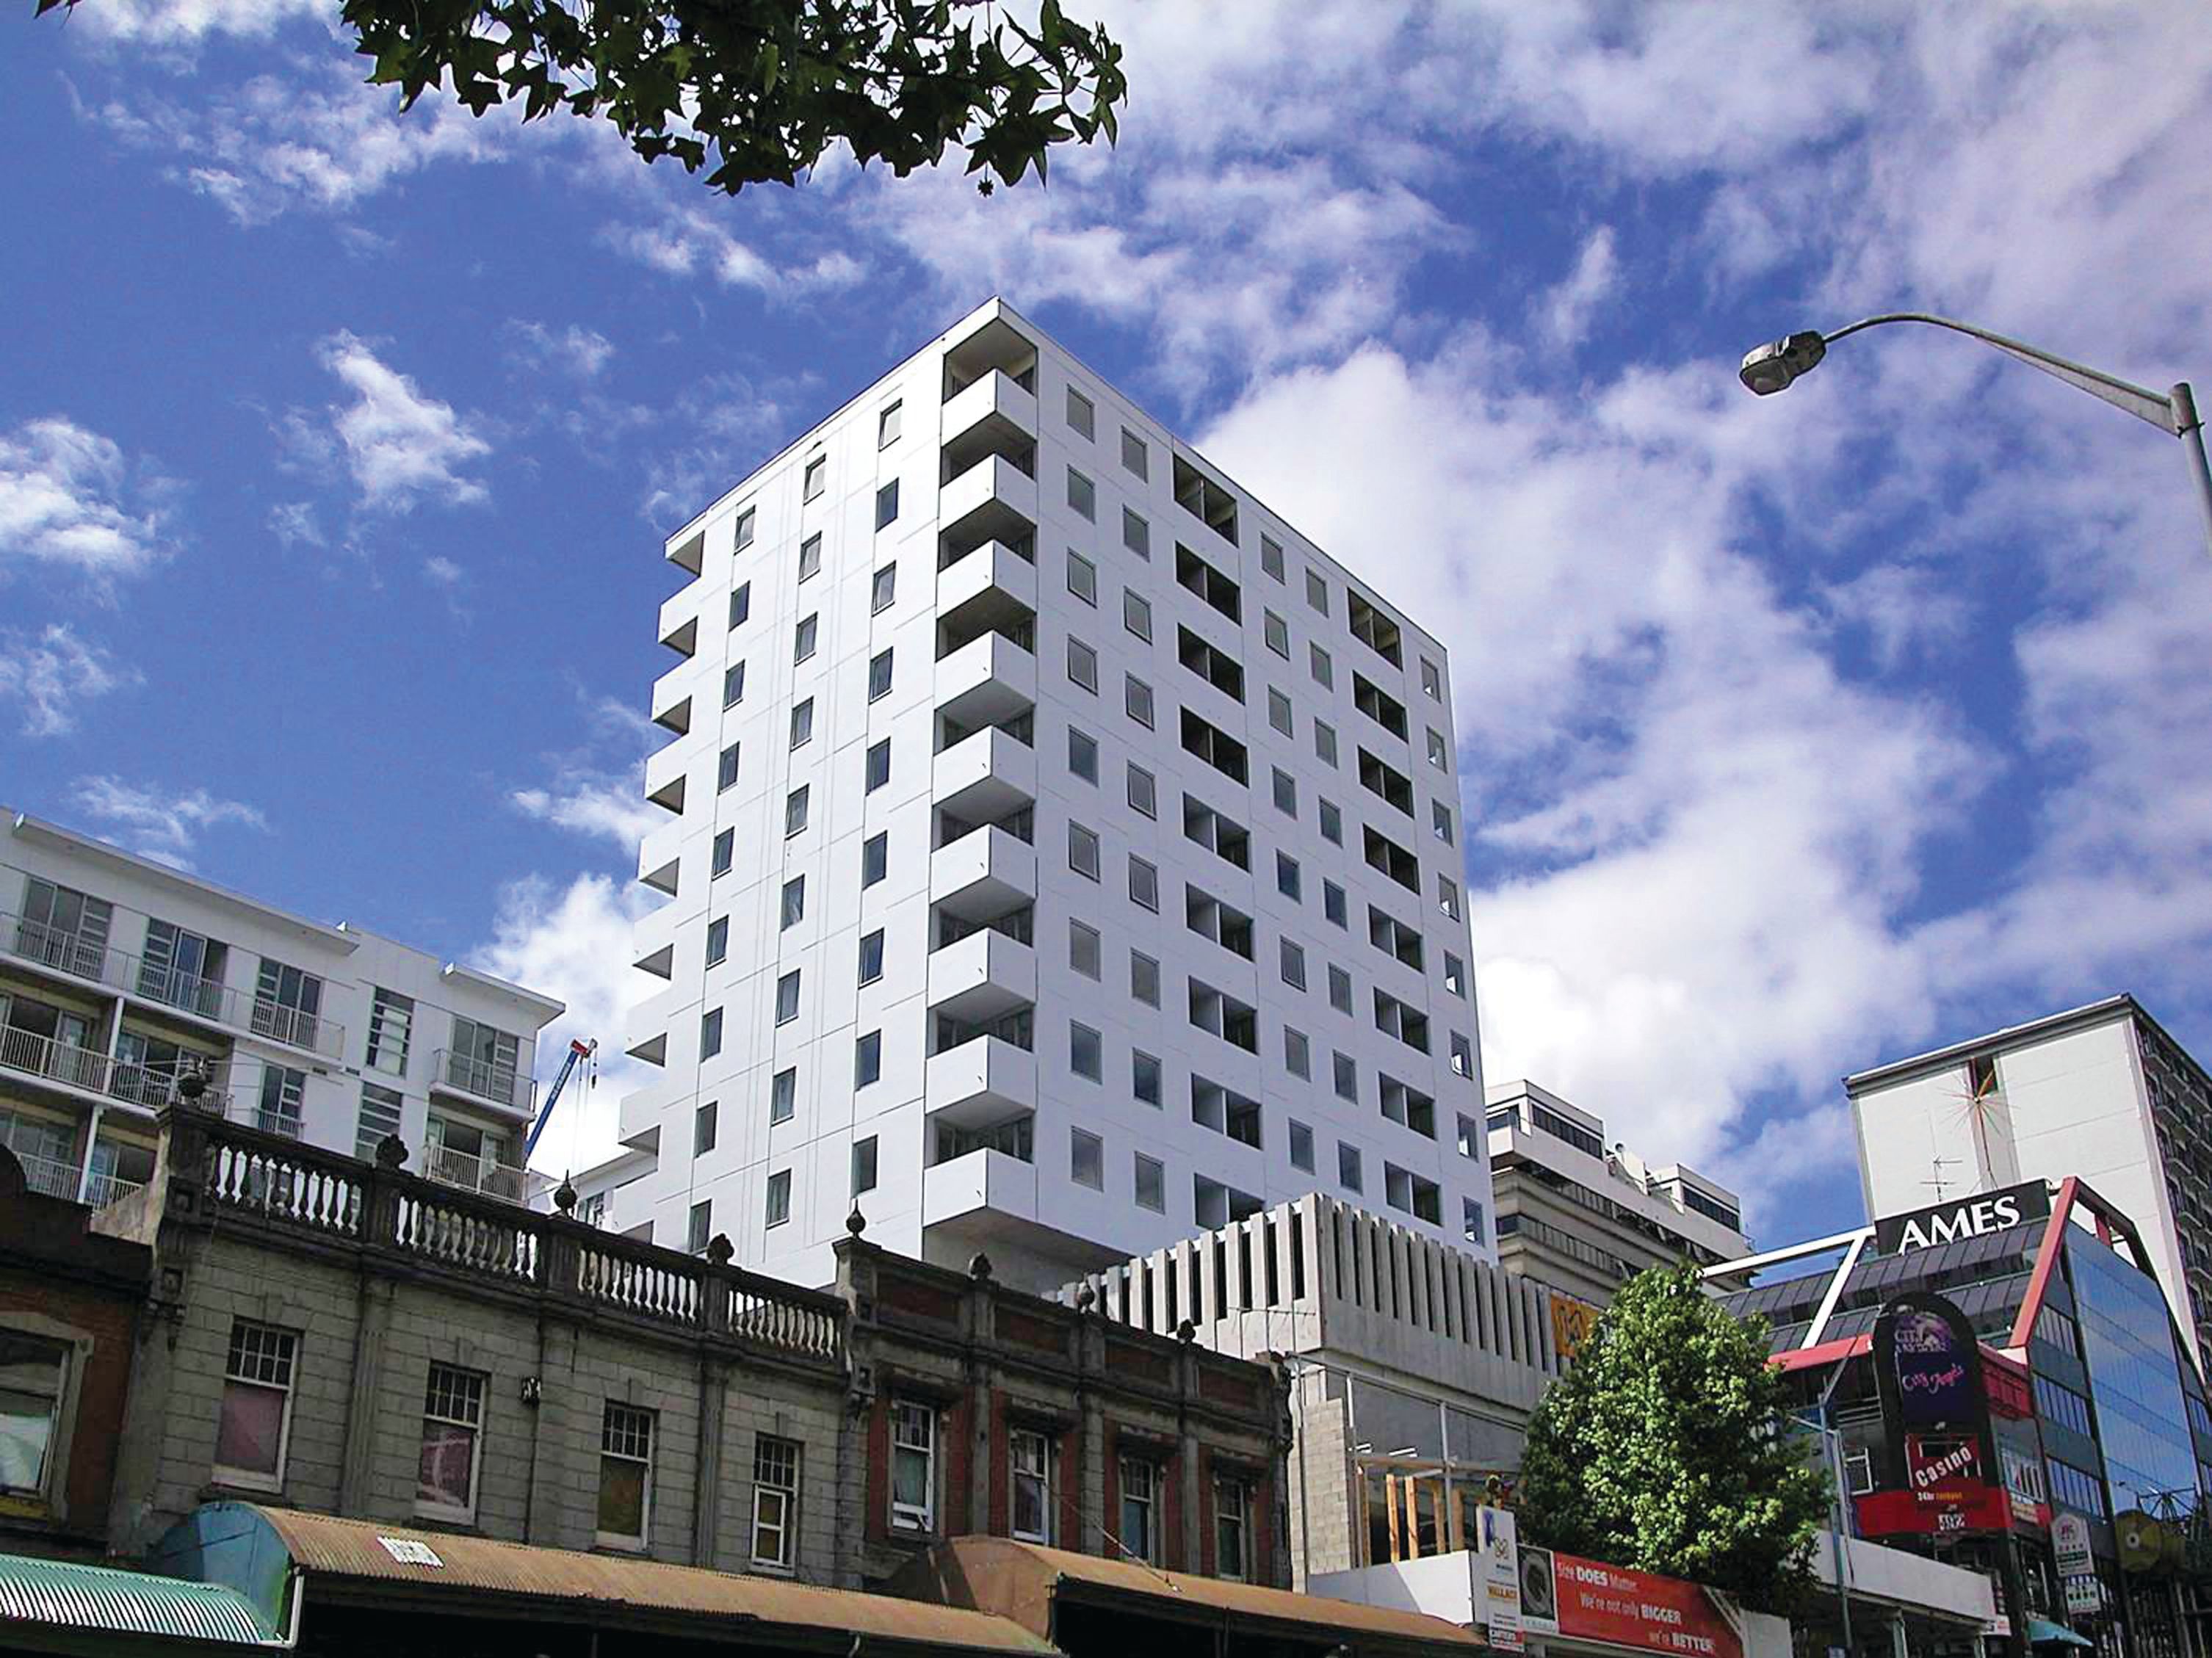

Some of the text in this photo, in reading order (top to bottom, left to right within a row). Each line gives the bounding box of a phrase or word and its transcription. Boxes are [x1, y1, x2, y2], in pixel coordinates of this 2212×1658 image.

[1898, 1196, 2020, 1256] AMES
[1915, 1447, 1972, 1488] Casino
[1576, 1565, 1608, 1587] DOES
[1641, 1604, 1681, 1625] BIGGER
